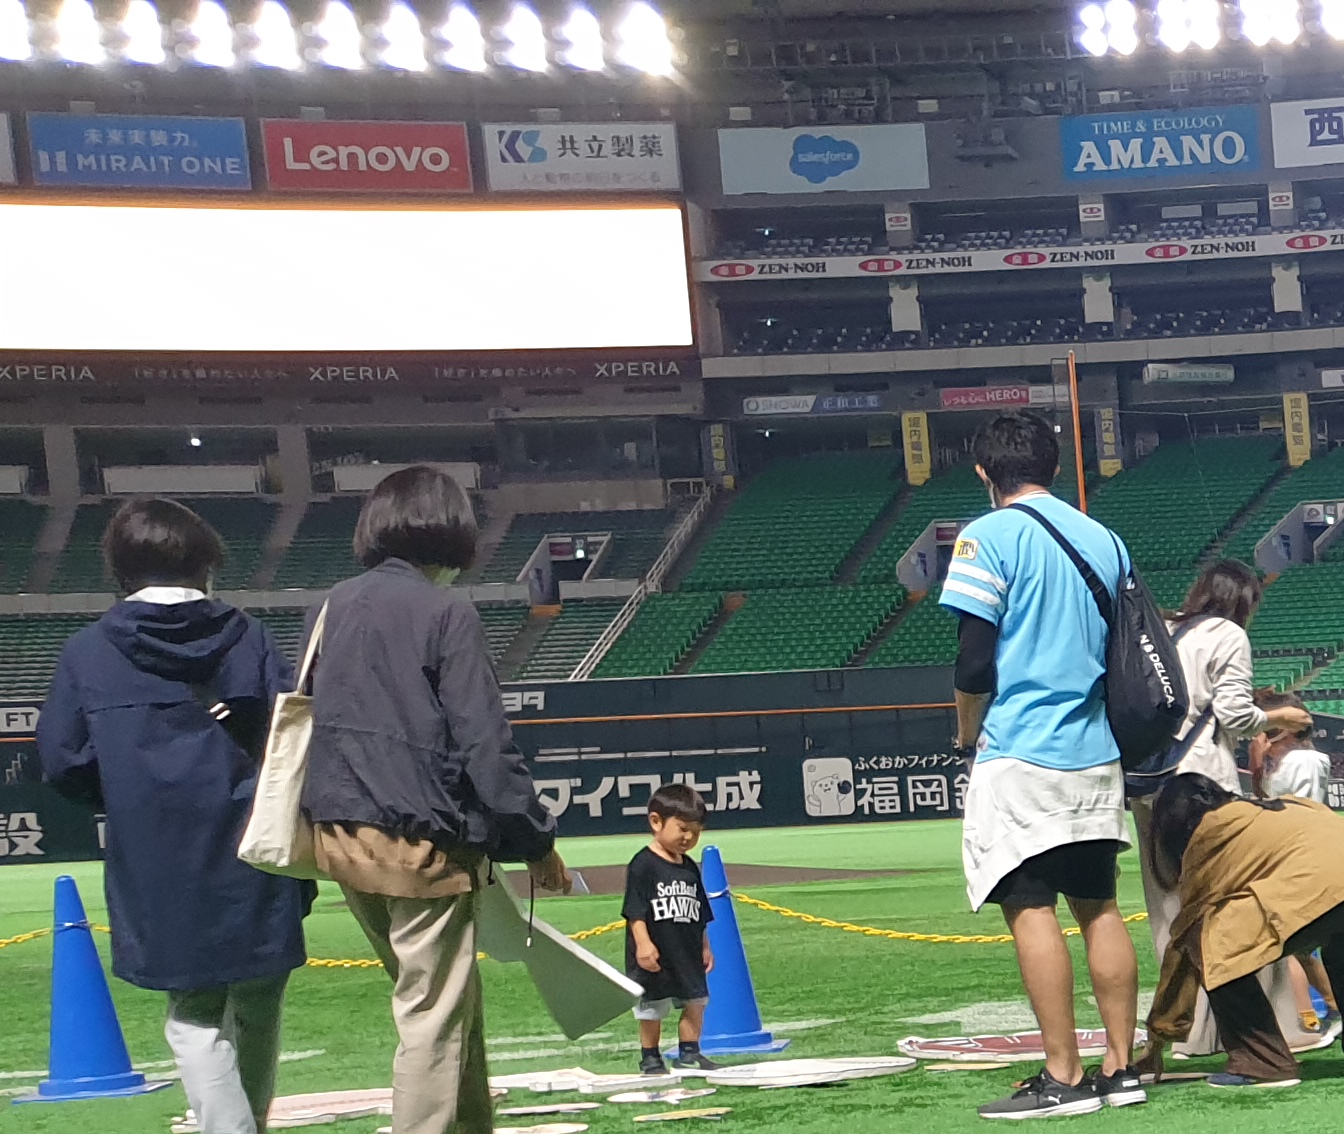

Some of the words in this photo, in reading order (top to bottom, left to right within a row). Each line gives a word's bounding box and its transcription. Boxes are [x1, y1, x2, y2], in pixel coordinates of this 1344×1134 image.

[1091, 120, 1131, 135] TIME
[1135, 120, 1147, 133] &
[1153, 114, 1225, 132] ECOLOGY
[557, 134, 664, 158] 共立製薬
[1073, 131, 1245, 172] AMANO
[77, 153, 173, 172] MIRAIT
[181, 157, 242, 174] ONE
[283, 137, 450, 173] Lenovo
[798, 152, 853, 164] salesforce
[1049, 249, 1116, 263] ZEN-NOH
[1191, 241, 1256, 255] ZEN-NOH
[758, 262, 827, 275] ZEN-NOH
[905, 256, 973, 270] ZEN-NOH
[0, 366, 95, 381] XPERIA
[309, 366, 400, 382] XPERIA
[594, 361, 682, 378] XPERIA
[1149, 652, 1176, 706] DELUCA
[5, 711, 35, 729] FT
[650, 896, 701, 922] HAWKS
